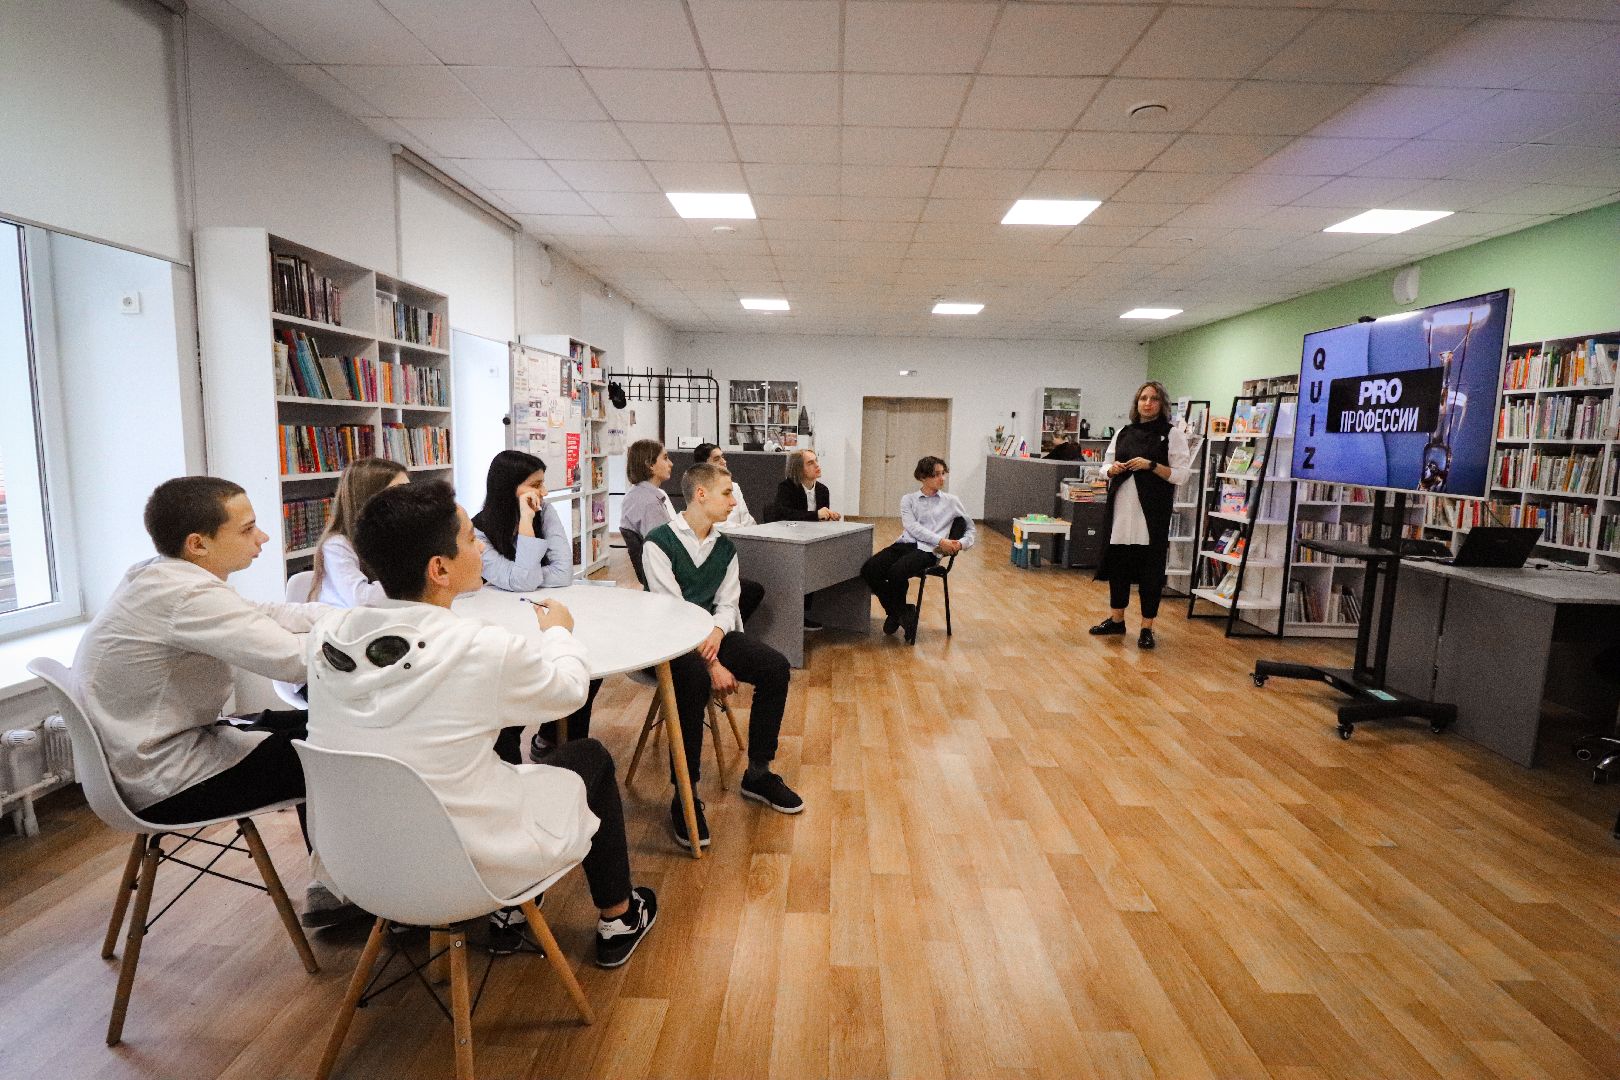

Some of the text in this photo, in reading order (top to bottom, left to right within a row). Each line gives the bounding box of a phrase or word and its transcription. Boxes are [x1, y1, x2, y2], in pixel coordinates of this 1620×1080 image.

[1358, 378, 1402, 405] PRO
[1302, 347, 1326, 470] QUIZ
[1340, 407, 1419, 432] ПРОФЕССИИ
